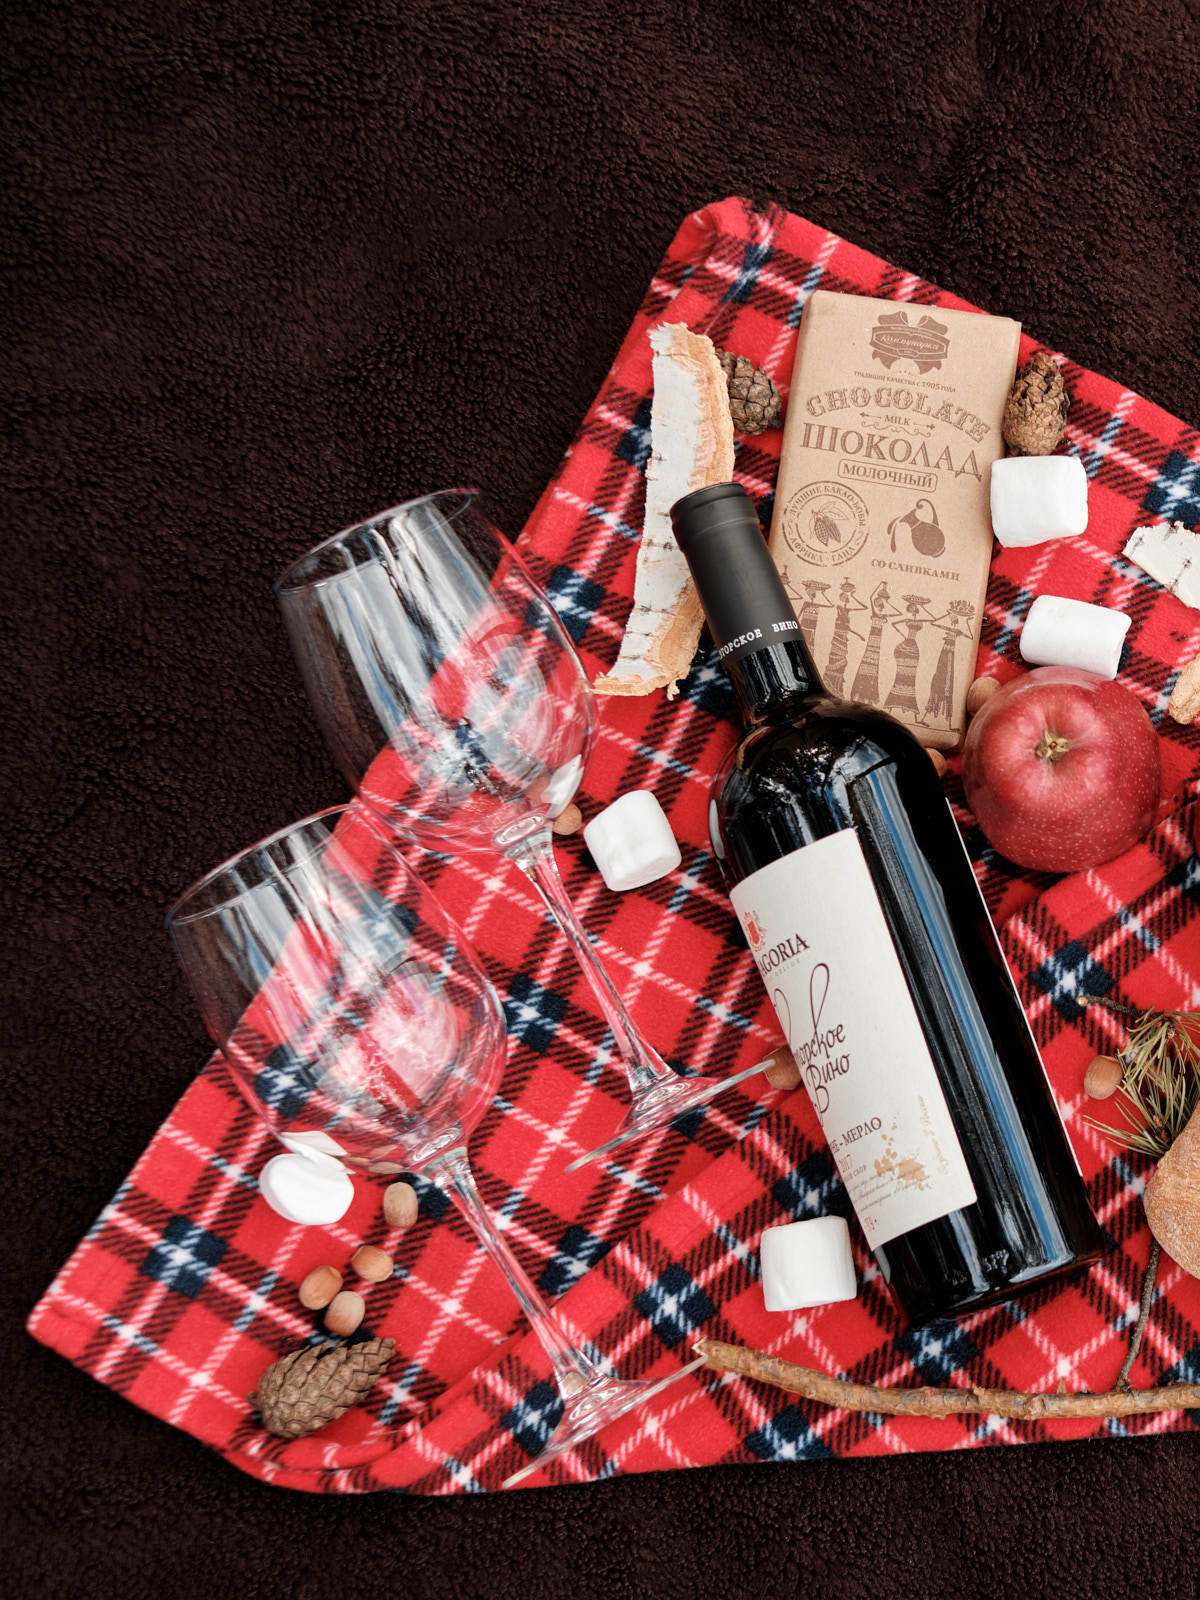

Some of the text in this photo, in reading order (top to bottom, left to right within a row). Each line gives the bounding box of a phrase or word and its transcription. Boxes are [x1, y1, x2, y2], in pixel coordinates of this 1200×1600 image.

[922, 381, 940, 391] 1905
[805, 386, 991, 444] CHOCOLATE
[884, 413, 912, 427] MILK
[800, 421, 983, 482] ШОКОЛАД
[842, 462, 933, 489] МОЛОЧНЫЙ
[789, 485, 866, 527] ЛУЧШИЕ КАКАО-БОБЫ
[789, 537, 856, 562] АФРИКА ГАНА
[871, 559, 960, 582] СО СЛИВКАМИ
[771, 619, 799, 633] ВИНО
